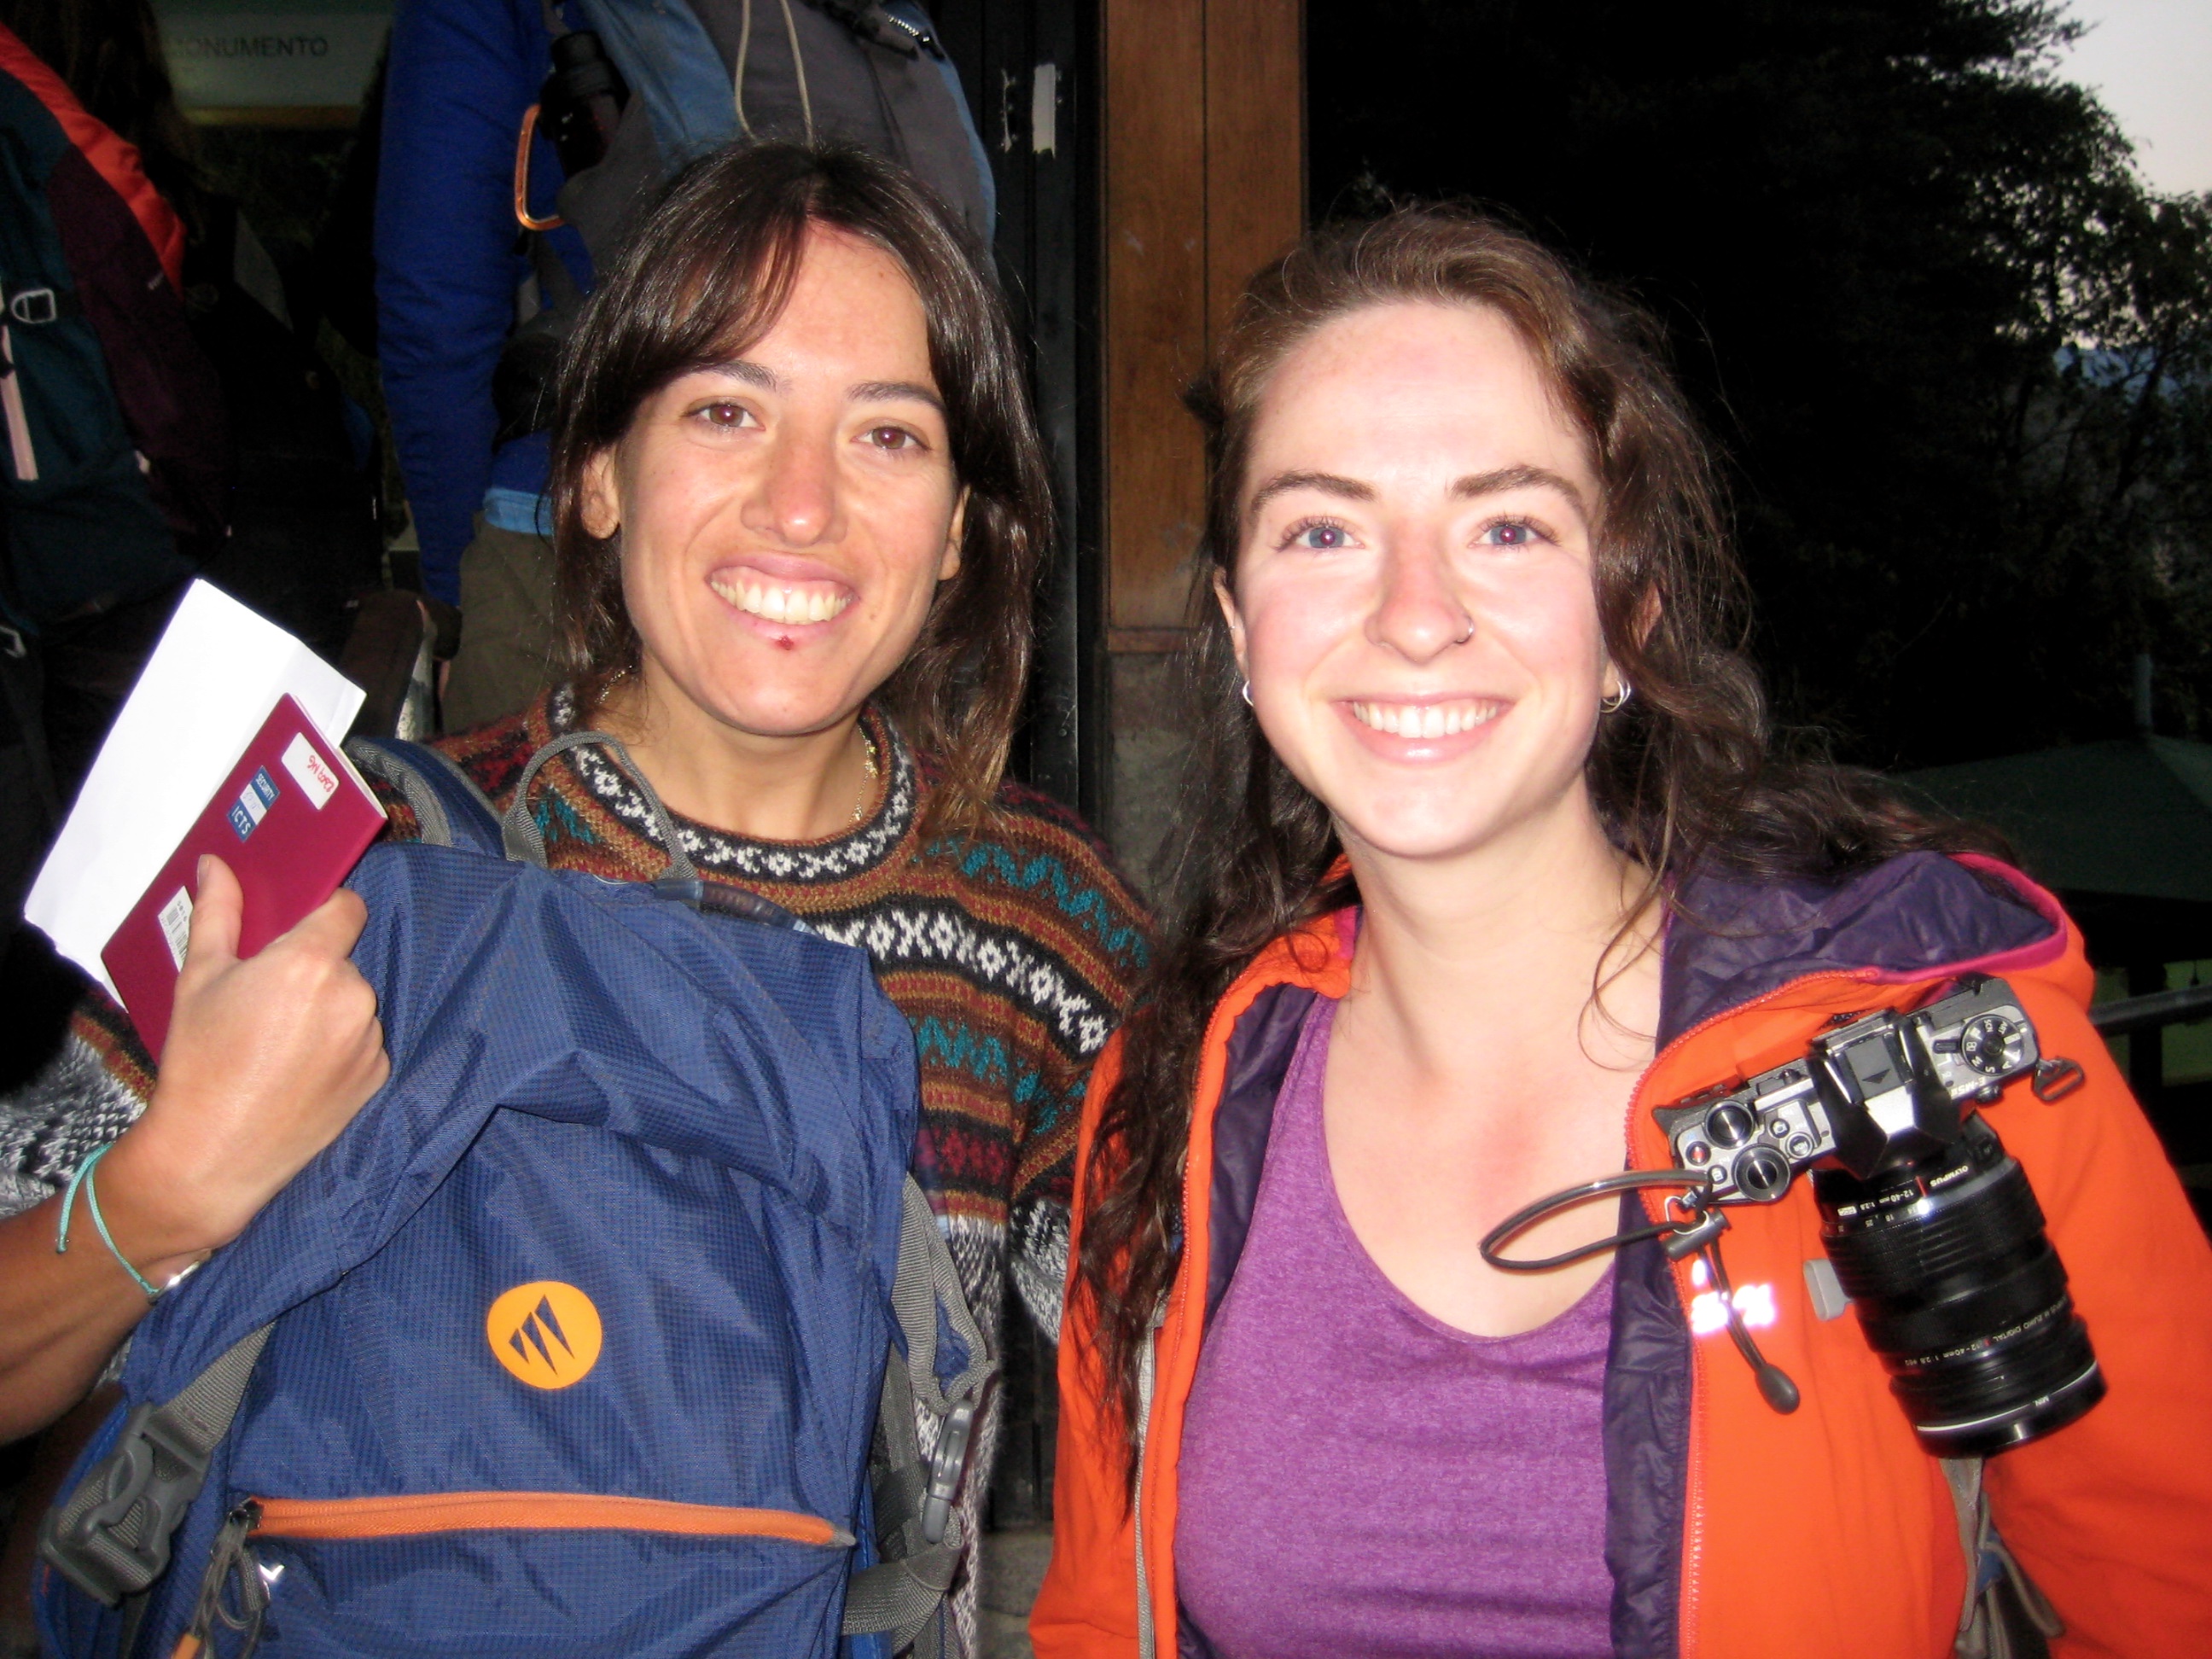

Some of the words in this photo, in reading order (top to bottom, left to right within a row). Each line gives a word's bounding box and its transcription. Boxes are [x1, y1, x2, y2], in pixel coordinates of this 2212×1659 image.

[255, 773, 276, 801] SECURITY
[231, 806, 252, 835] ICTS
[1929, 1165, 1969, 1187] OLYMPUS
